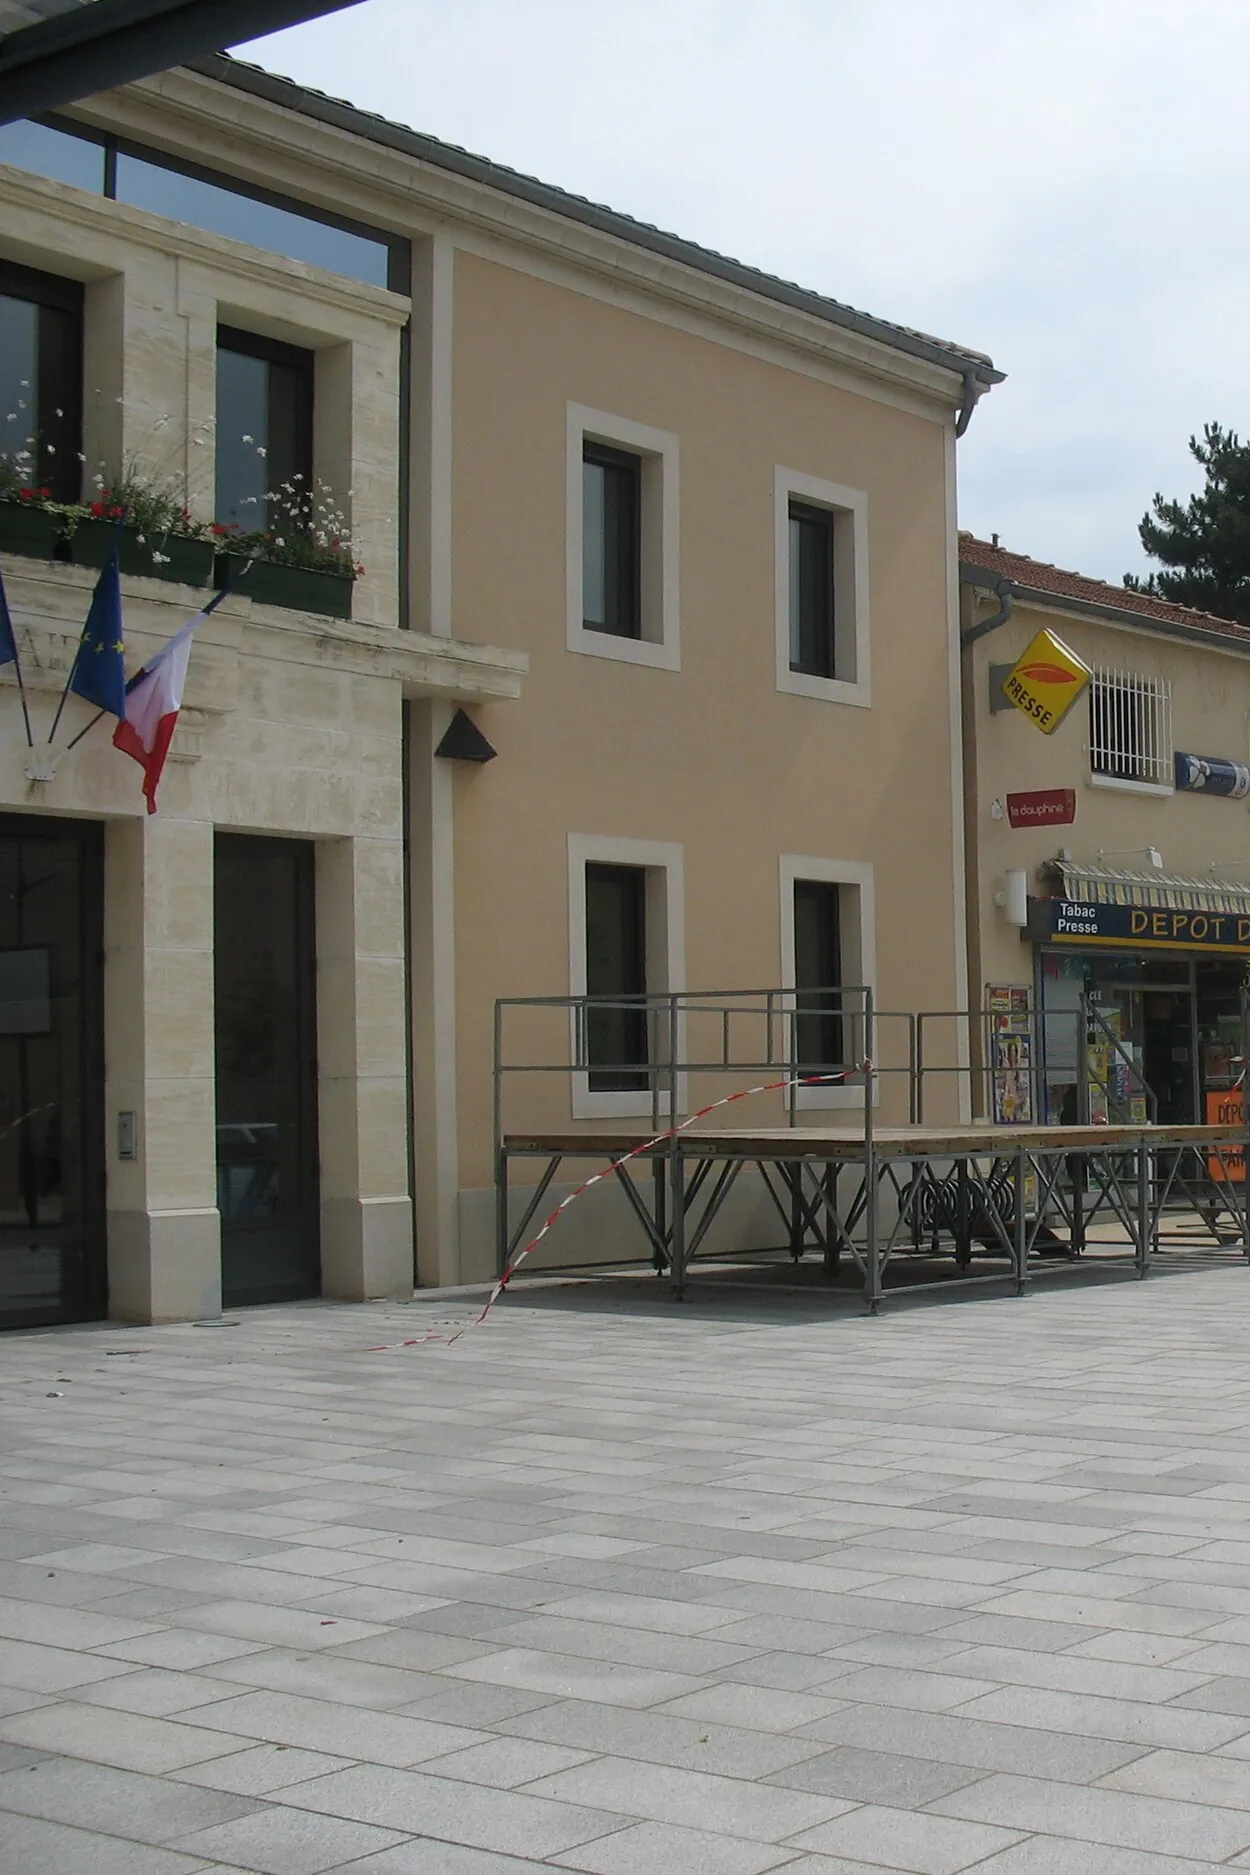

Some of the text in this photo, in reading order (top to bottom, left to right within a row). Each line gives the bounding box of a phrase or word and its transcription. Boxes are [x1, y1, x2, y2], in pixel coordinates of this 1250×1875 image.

[1007, 677, 1053, 725] PRESSE
[1060, 903, 1096, 918] Tabac
[1058, 919, 1098, 934] Presse
[1131, 911, 1226, 940] DEPOT
